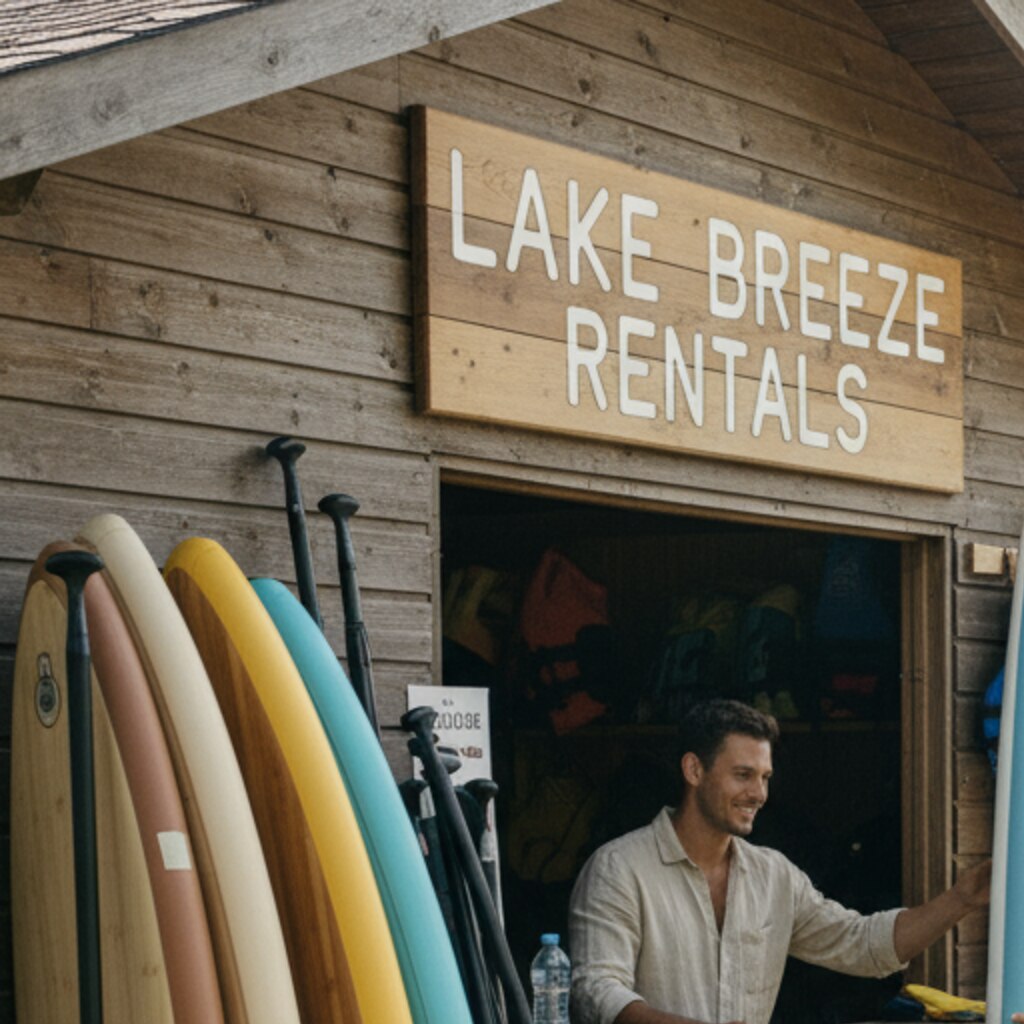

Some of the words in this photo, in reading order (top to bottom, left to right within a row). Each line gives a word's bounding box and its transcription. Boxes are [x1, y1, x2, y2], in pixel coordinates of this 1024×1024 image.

[449, 147, 660, 302] LAKE
[708, 216, 946, 364] BREEZE
[566, 305, 869, 455] RENTALS
